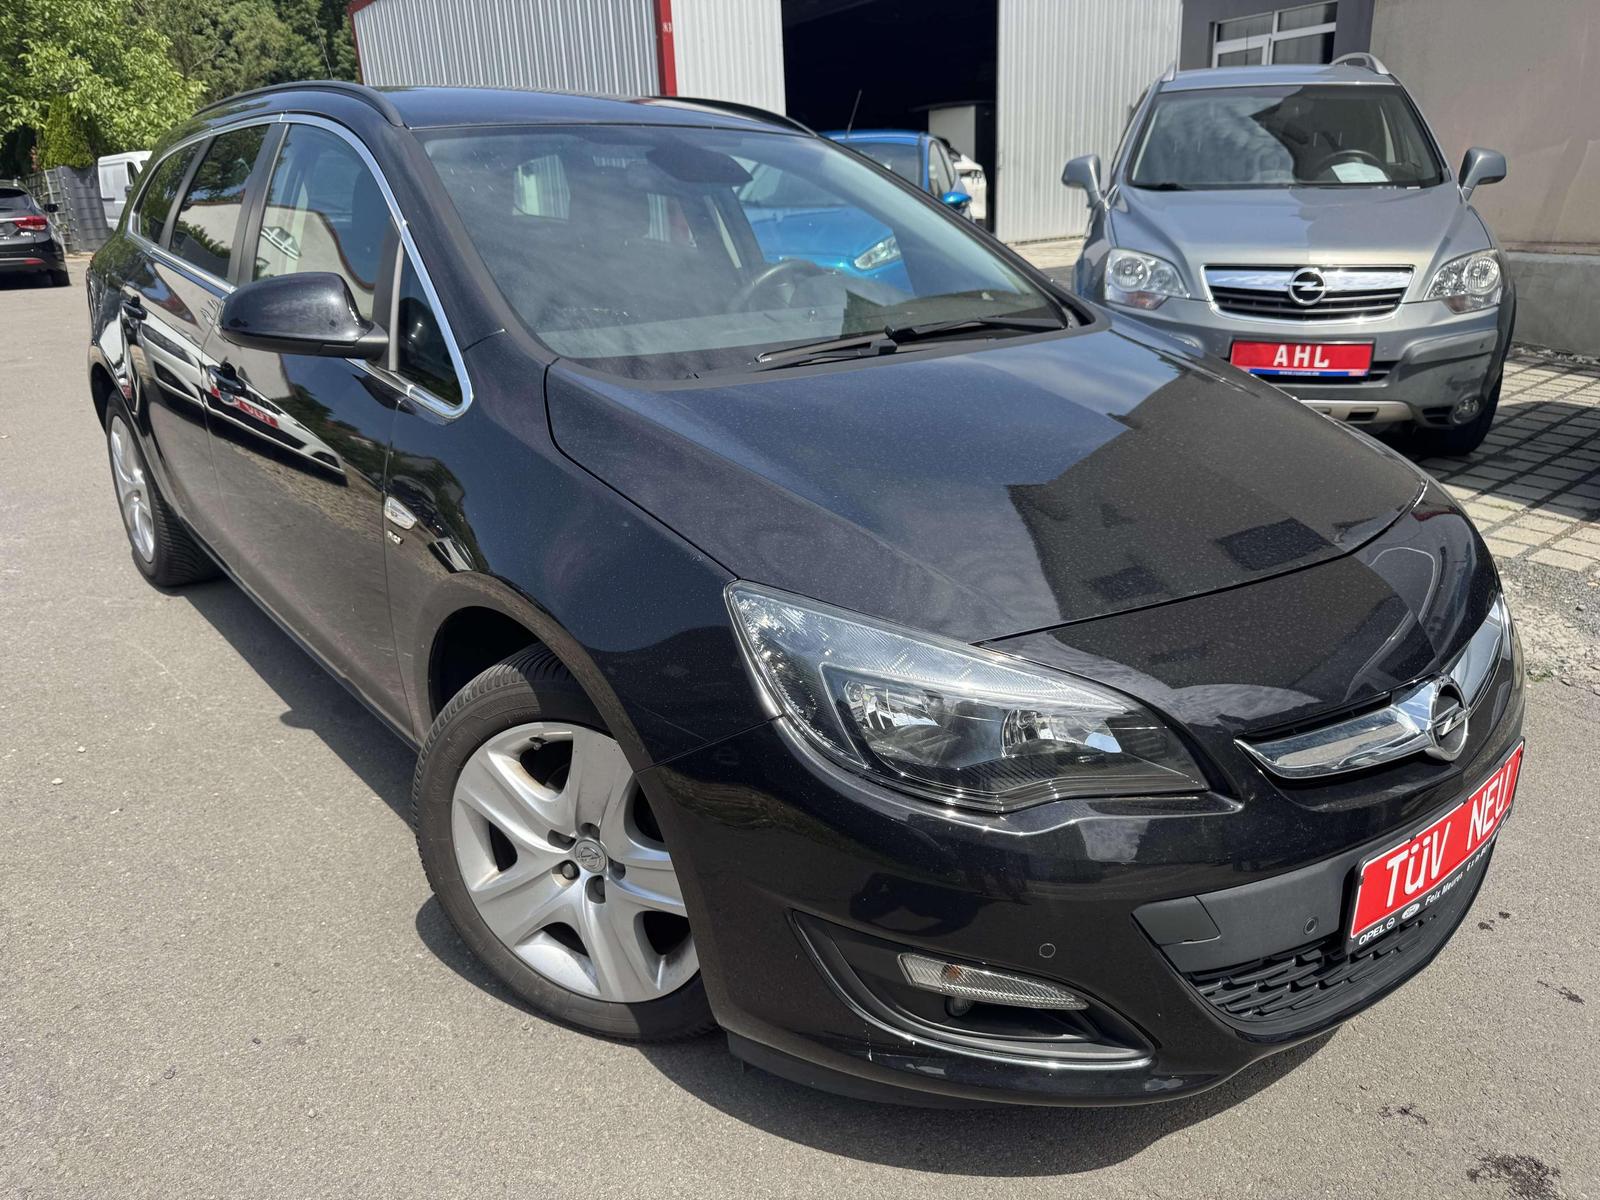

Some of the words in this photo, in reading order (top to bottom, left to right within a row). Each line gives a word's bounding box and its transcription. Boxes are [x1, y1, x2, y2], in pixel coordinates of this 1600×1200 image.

[1273, 344, 1330, 368] AHL
[1385, 821, 1451, 908] TÜV
[1466, 764, 1511, 851] NEU
[1358, 924, 1385, 945] OPEL
